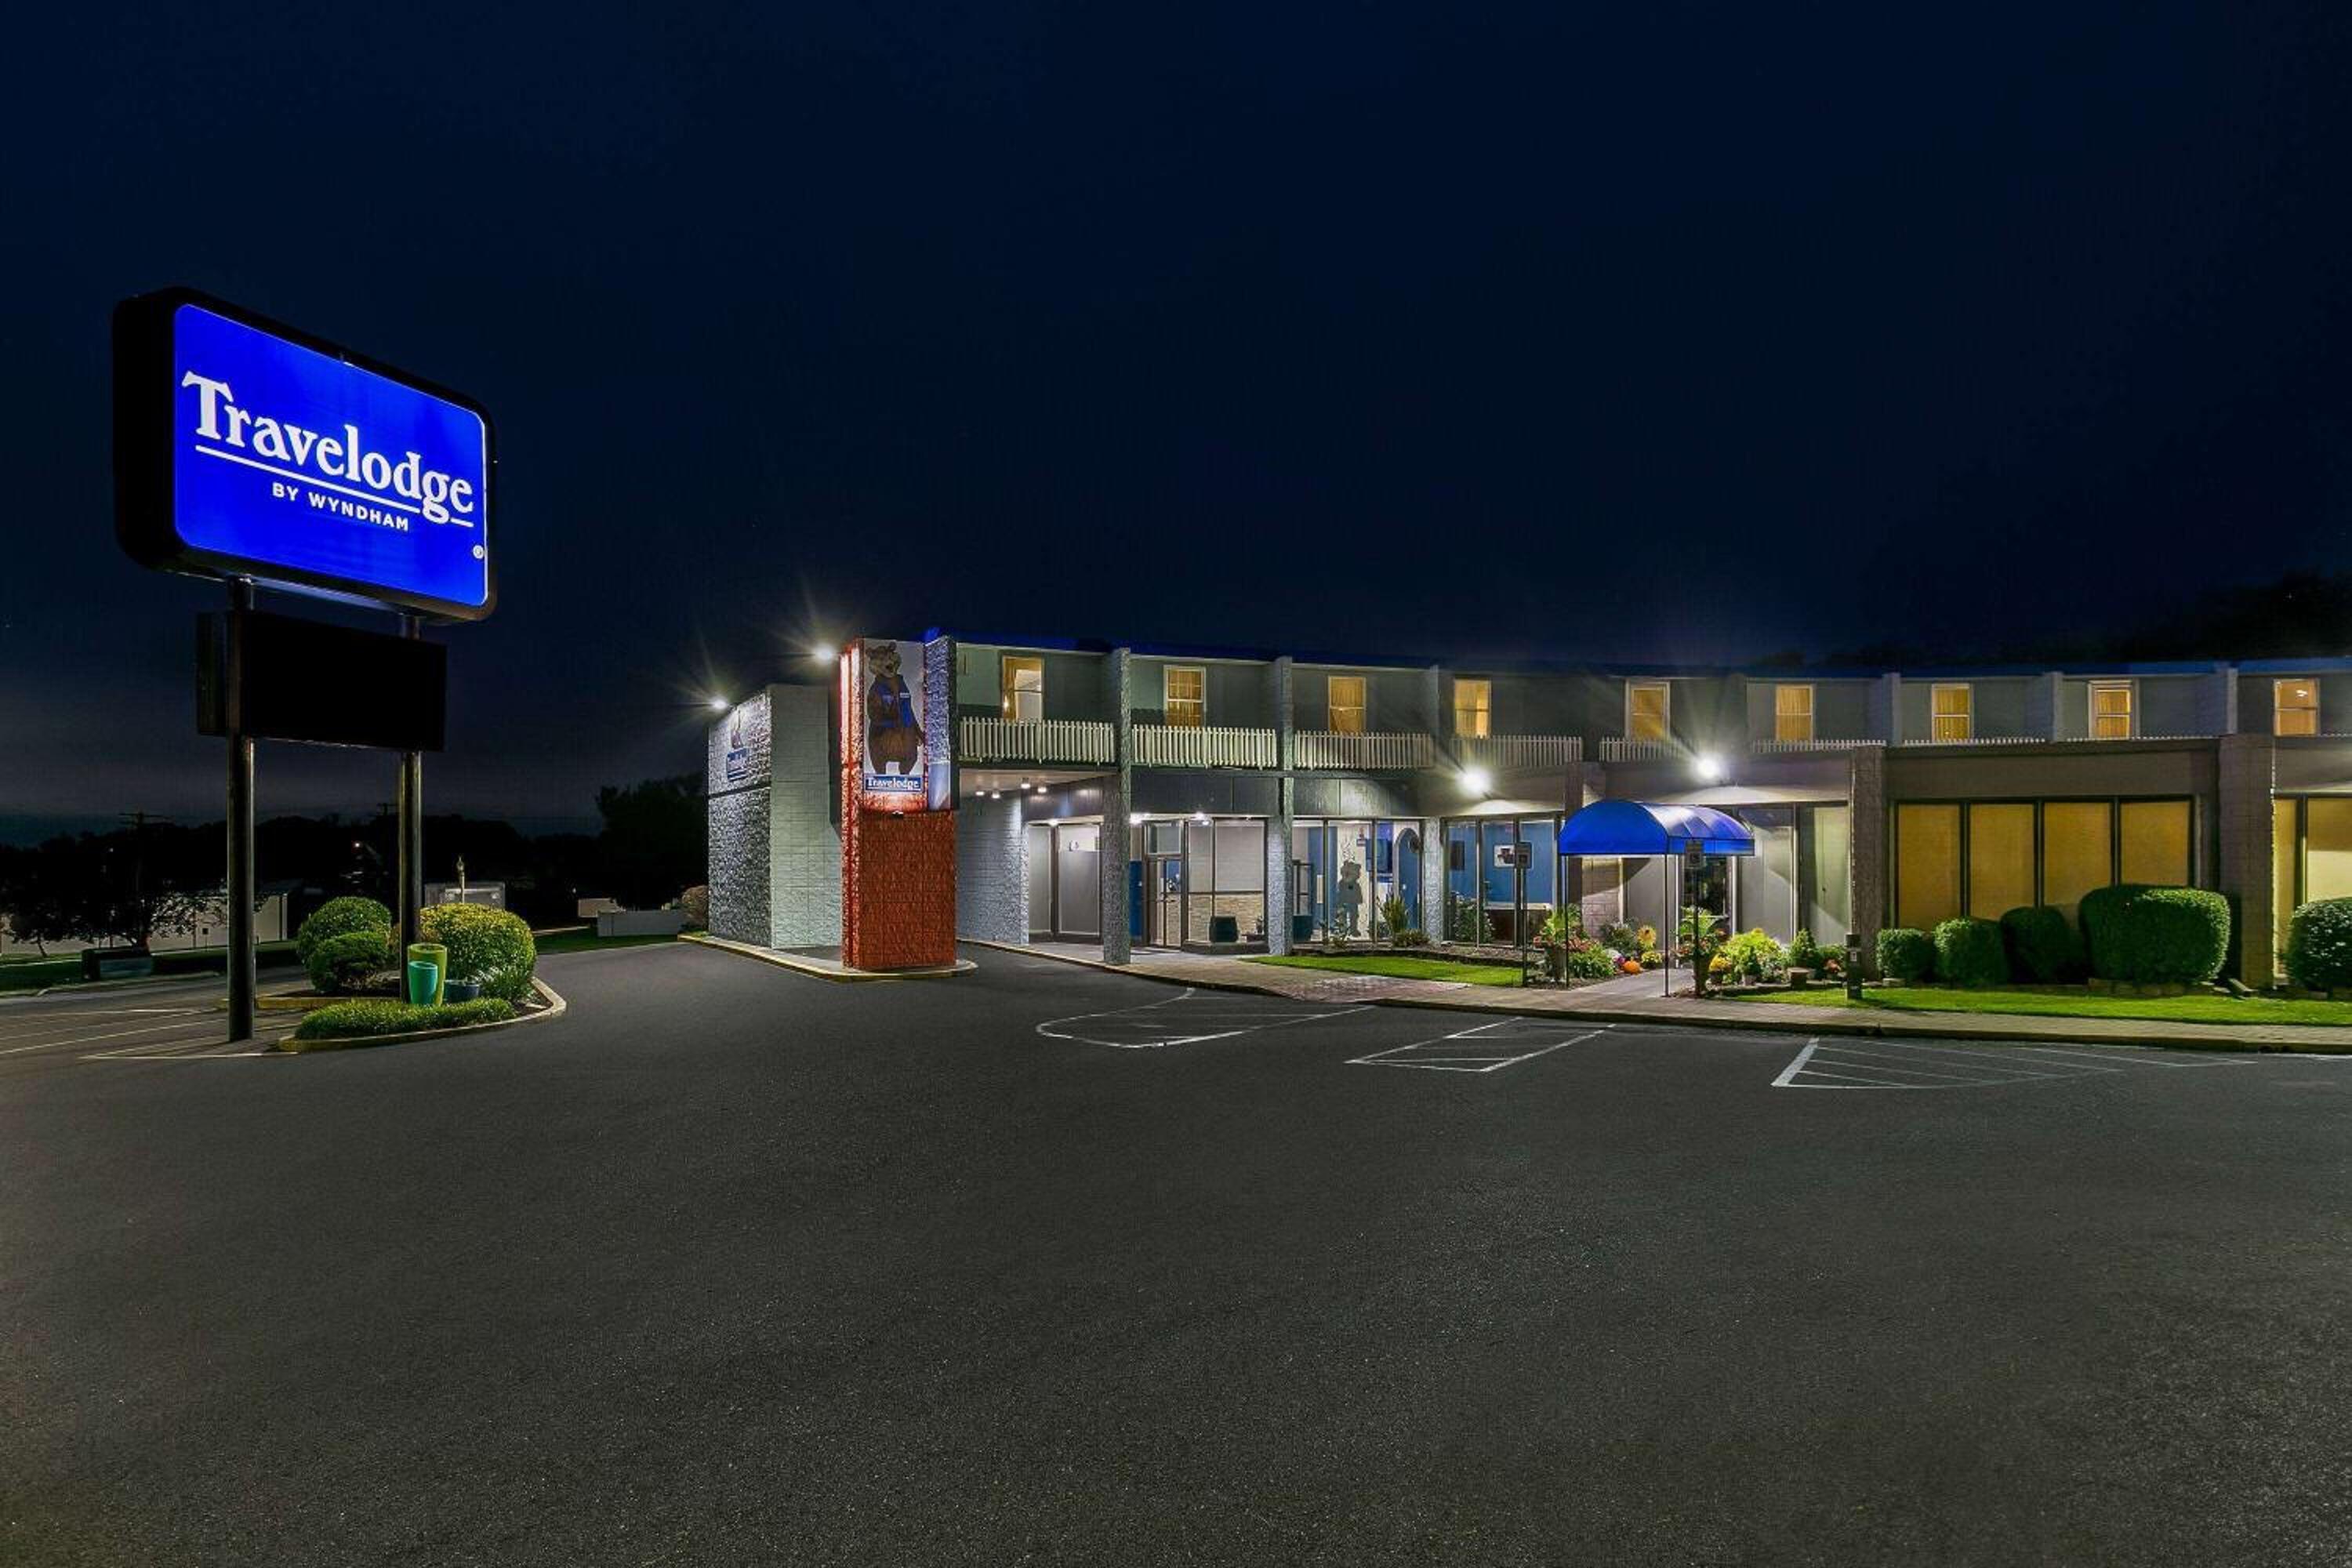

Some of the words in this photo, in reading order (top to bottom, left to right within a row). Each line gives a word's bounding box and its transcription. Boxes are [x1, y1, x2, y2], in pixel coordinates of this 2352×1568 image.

[181, 370, 474, 524] Travelodge
[272, 481, 299, 502] BY
[308, 492, 409, 532] WYNDHAM
[868, 777, 919, 790] Travelodge
